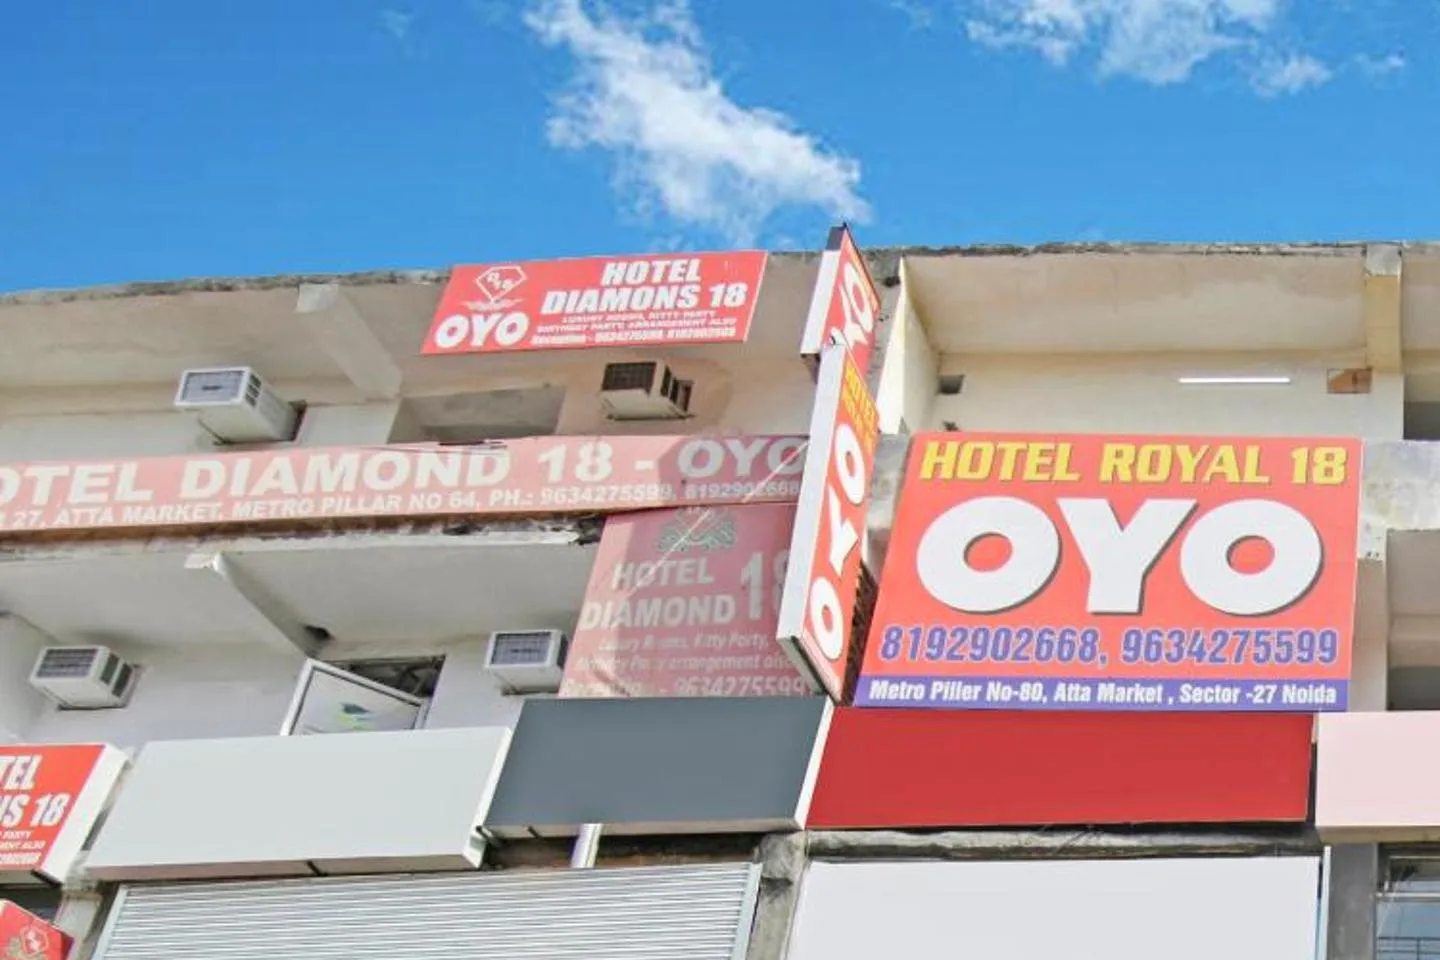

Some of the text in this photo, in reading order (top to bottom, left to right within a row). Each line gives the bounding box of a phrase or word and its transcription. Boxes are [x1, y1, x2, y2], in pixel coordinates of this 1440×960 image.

[601, 258, 702, 287] HOTEL
[540, 285, 700, 315] DIAMONS
[709, 282, 749, 308] 18
[831, 261, 874, 350] OY
[434, 311, 530, 349] OYO
[180, 445, 510, 502] DIAMOND
[538, 442, 613, 484] 18
[678, 436, 803, 477] OYO
[919, 440, 1348, 486] HOTEL ROYAL 18
[54, 506, 114, 526] ATTA
[232, 497, 317, 519] METRO
[321, 494, 400, 516] PILLAR
[408, 492, 442, 512] NO
[810, 423, 866, 660] OYO
[915, 495, 1325, 617] OYO
[612, 557, 715, 592] HOTEL
[578, 594, 737, 631] DIAMOND
[880, 626, 1339, 666] 8192902668, 9634275599
[869, 681, 925, 701] Metro
[929, 681, 982, 701] Piller
[1054, 682, 1091, 702] Atta
[1099, 682, 1163, 703] Market
[1179, 683, 1240, 703] Sector
[1281, 683, 1338, 705] Noida
[30, 793, 72, 828] 18
